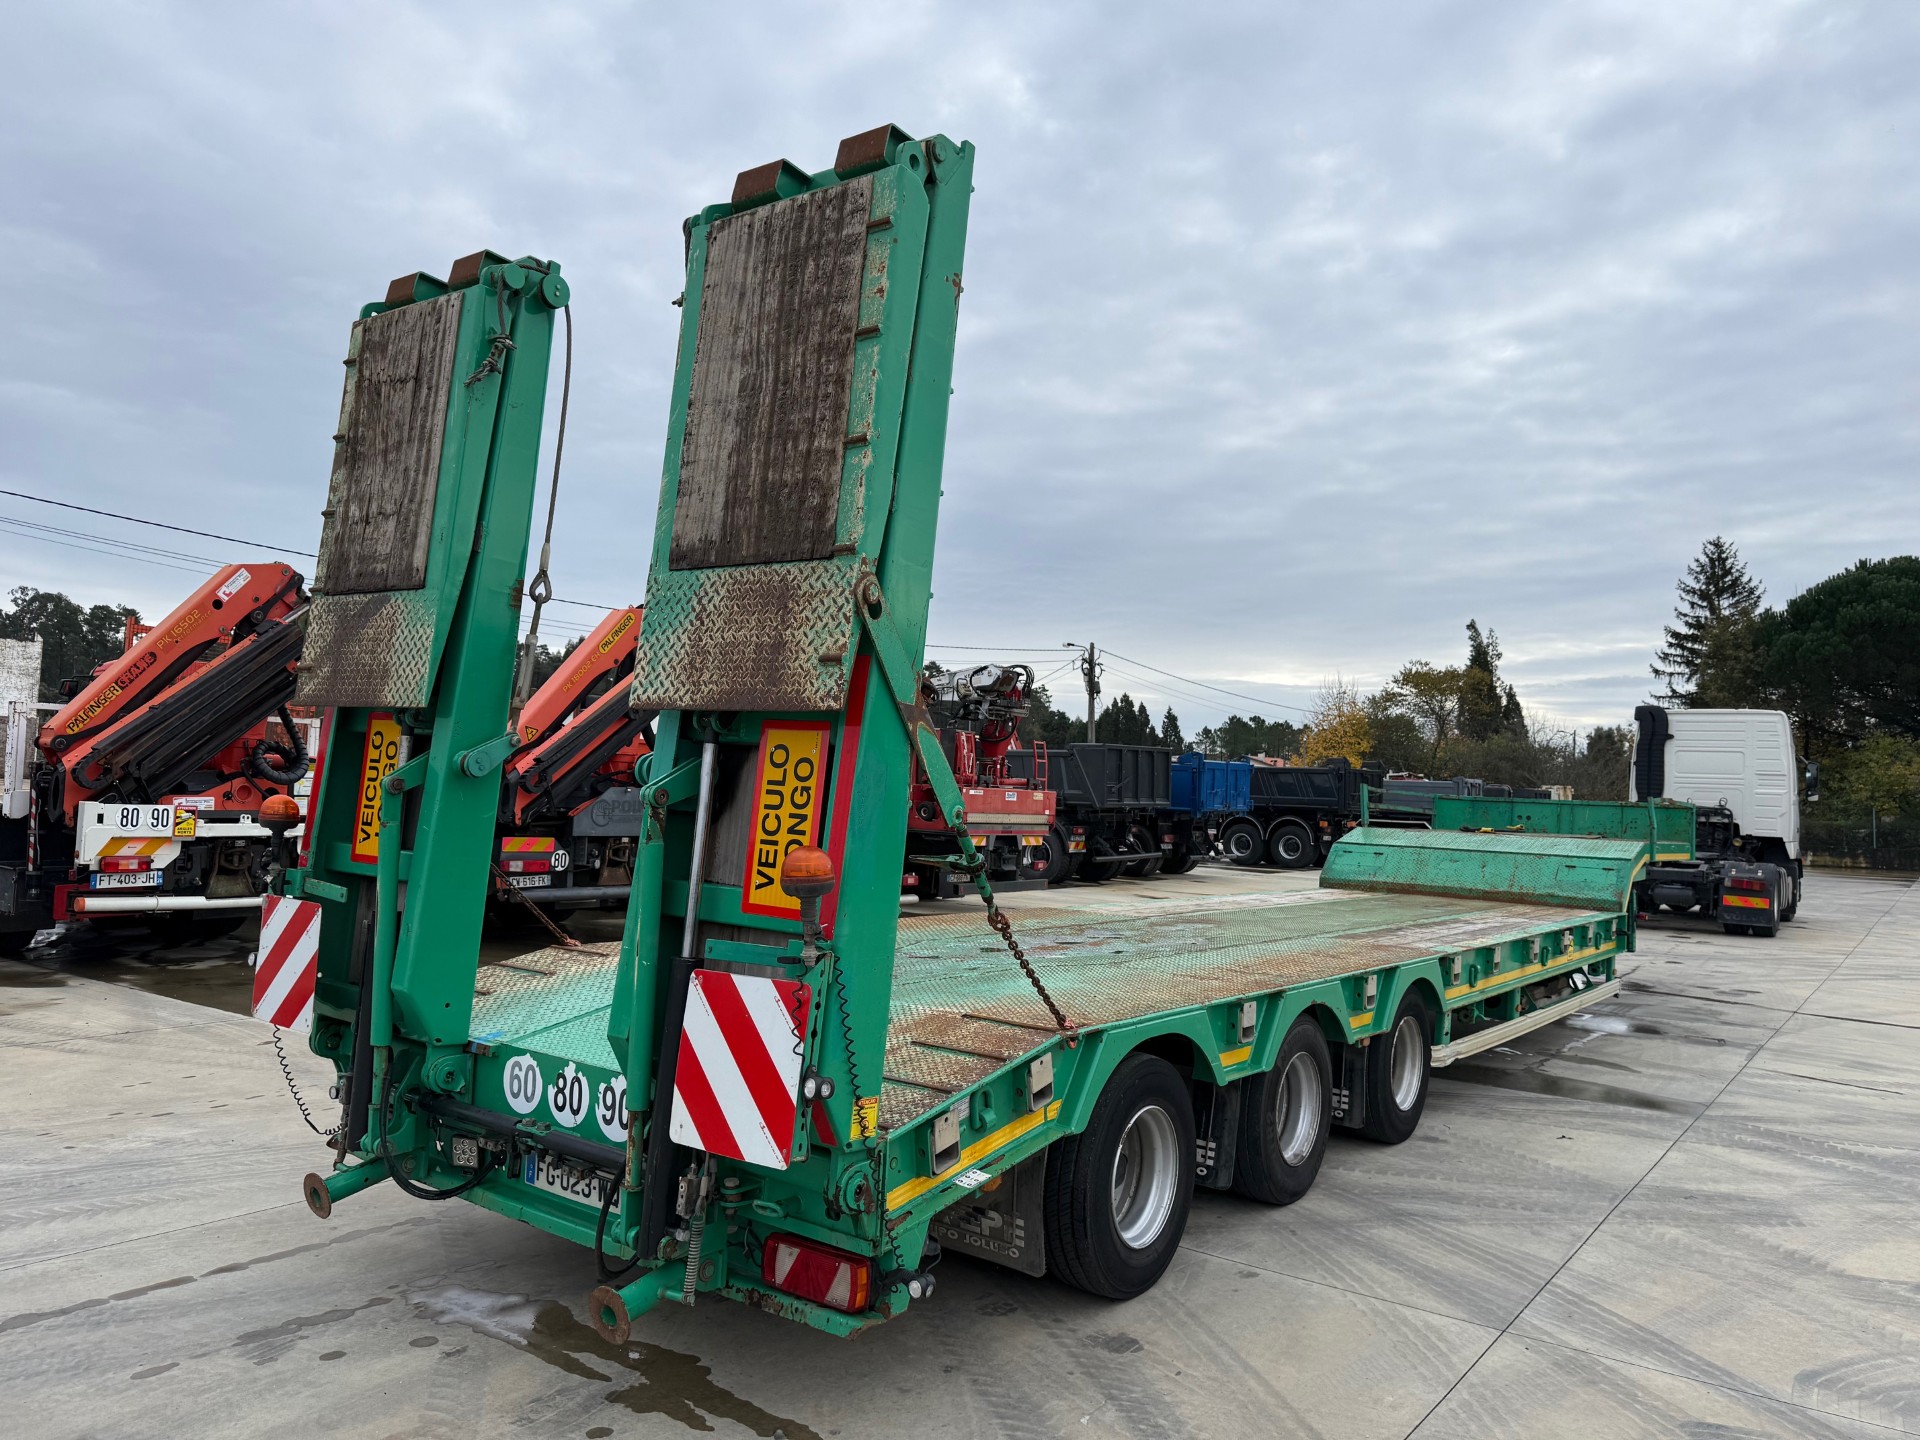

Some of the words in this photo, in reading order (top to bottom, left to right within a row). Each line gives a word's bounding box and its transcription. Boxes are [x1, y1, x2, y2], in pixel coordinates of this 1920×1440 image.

[156, 634, 171, 649] PK
[171, 609, 201, 637] 16502
[600, 615, 634, 651] PALFINGER
[562, 683, 573, 692] PK
[358, 730, 384, 844] VEICULO
[120, 807, 140, 828] 80
[151, 808, 170, 828] 90
[755, 743, 790, 891] VEICULO
[784, 756, 815, 859] ONGO
[98, 873, 156, 886] FT-403-JH
[554, 852, 567, 869] 80
[509, 1060, 537, 1104] 60
[553, 1072, 583, 1117] 80
[601, 1085, 629, 1131] 90
[963, 1233, 1020, 1259] JOLUO
